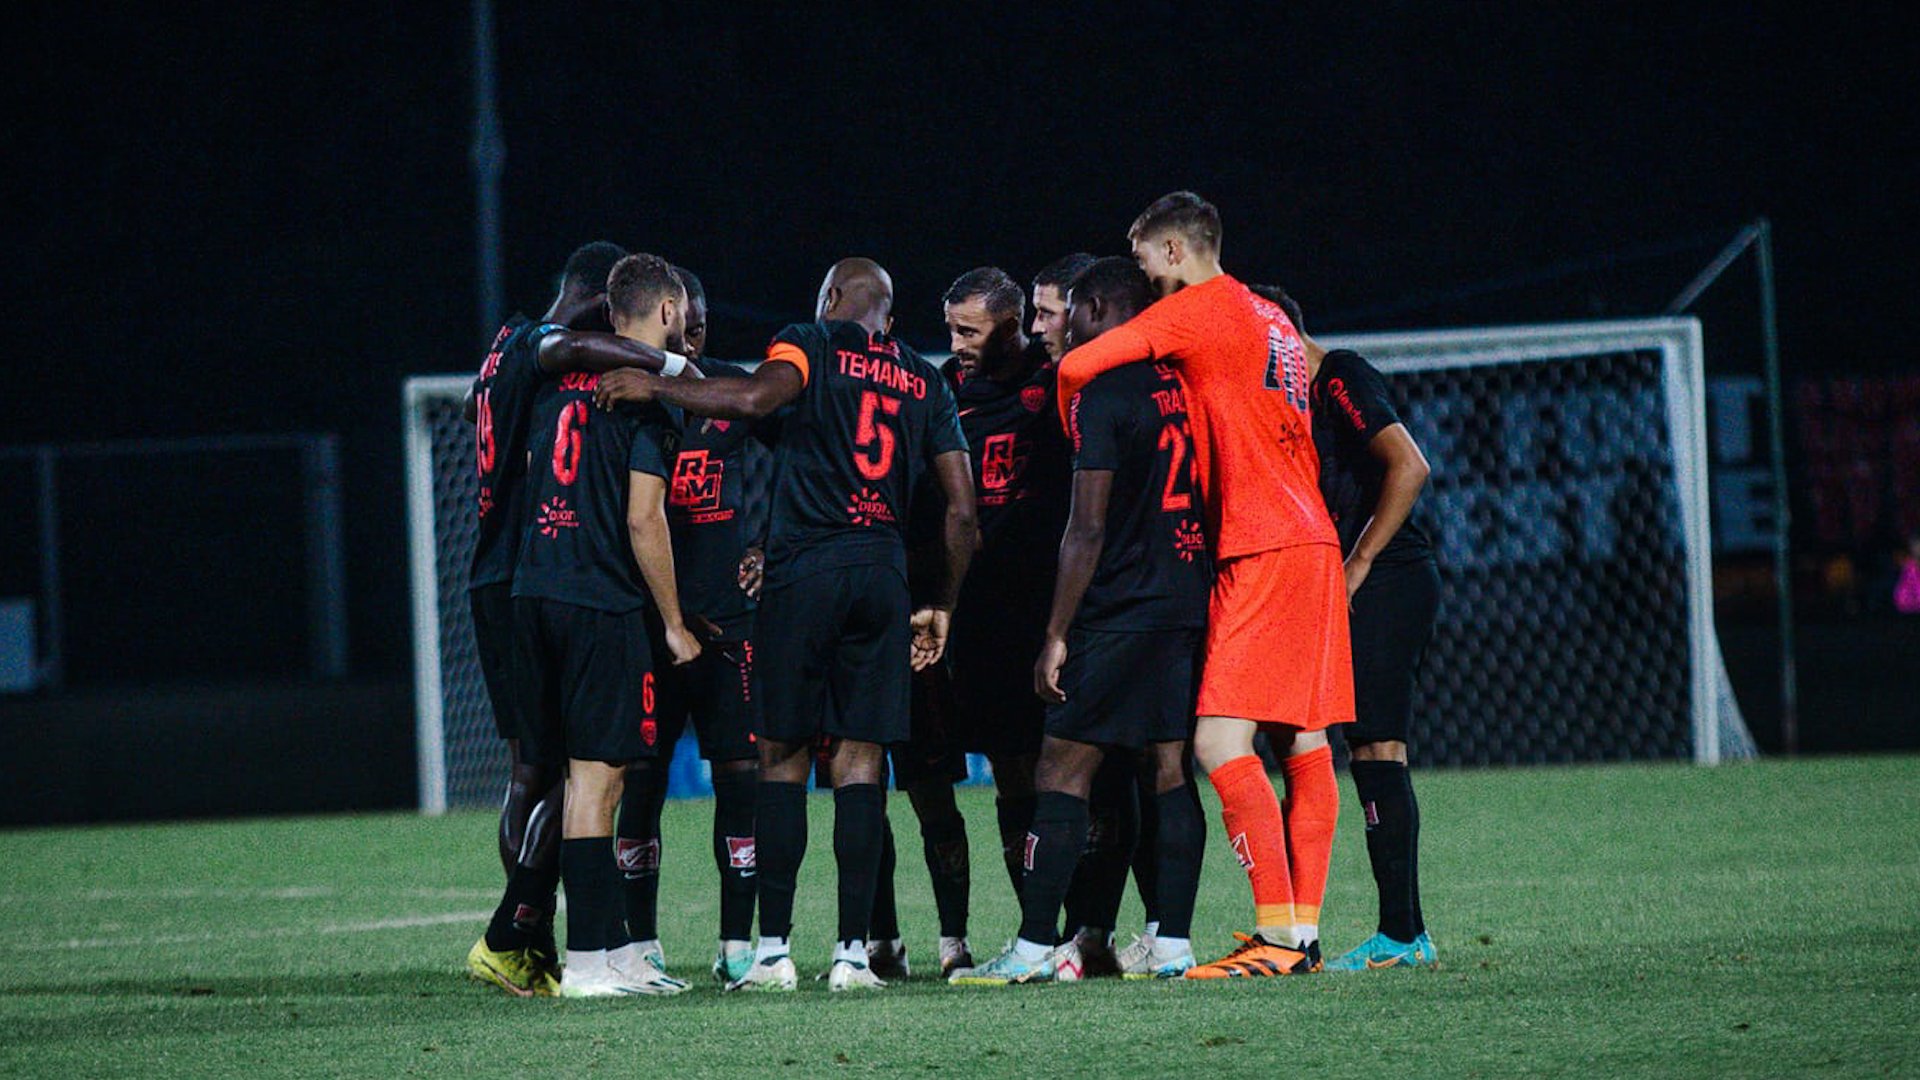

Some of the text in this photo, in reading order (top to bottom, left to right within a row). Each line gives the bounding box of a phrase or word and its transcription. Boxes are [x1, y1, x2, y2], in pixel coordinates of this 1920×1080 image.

[836, 348, 927, 400] TEMANFO
[552, 399, 589, 486] 6
[853, 389, 902, 481] 5
[642, 671, 656, 715] 6
